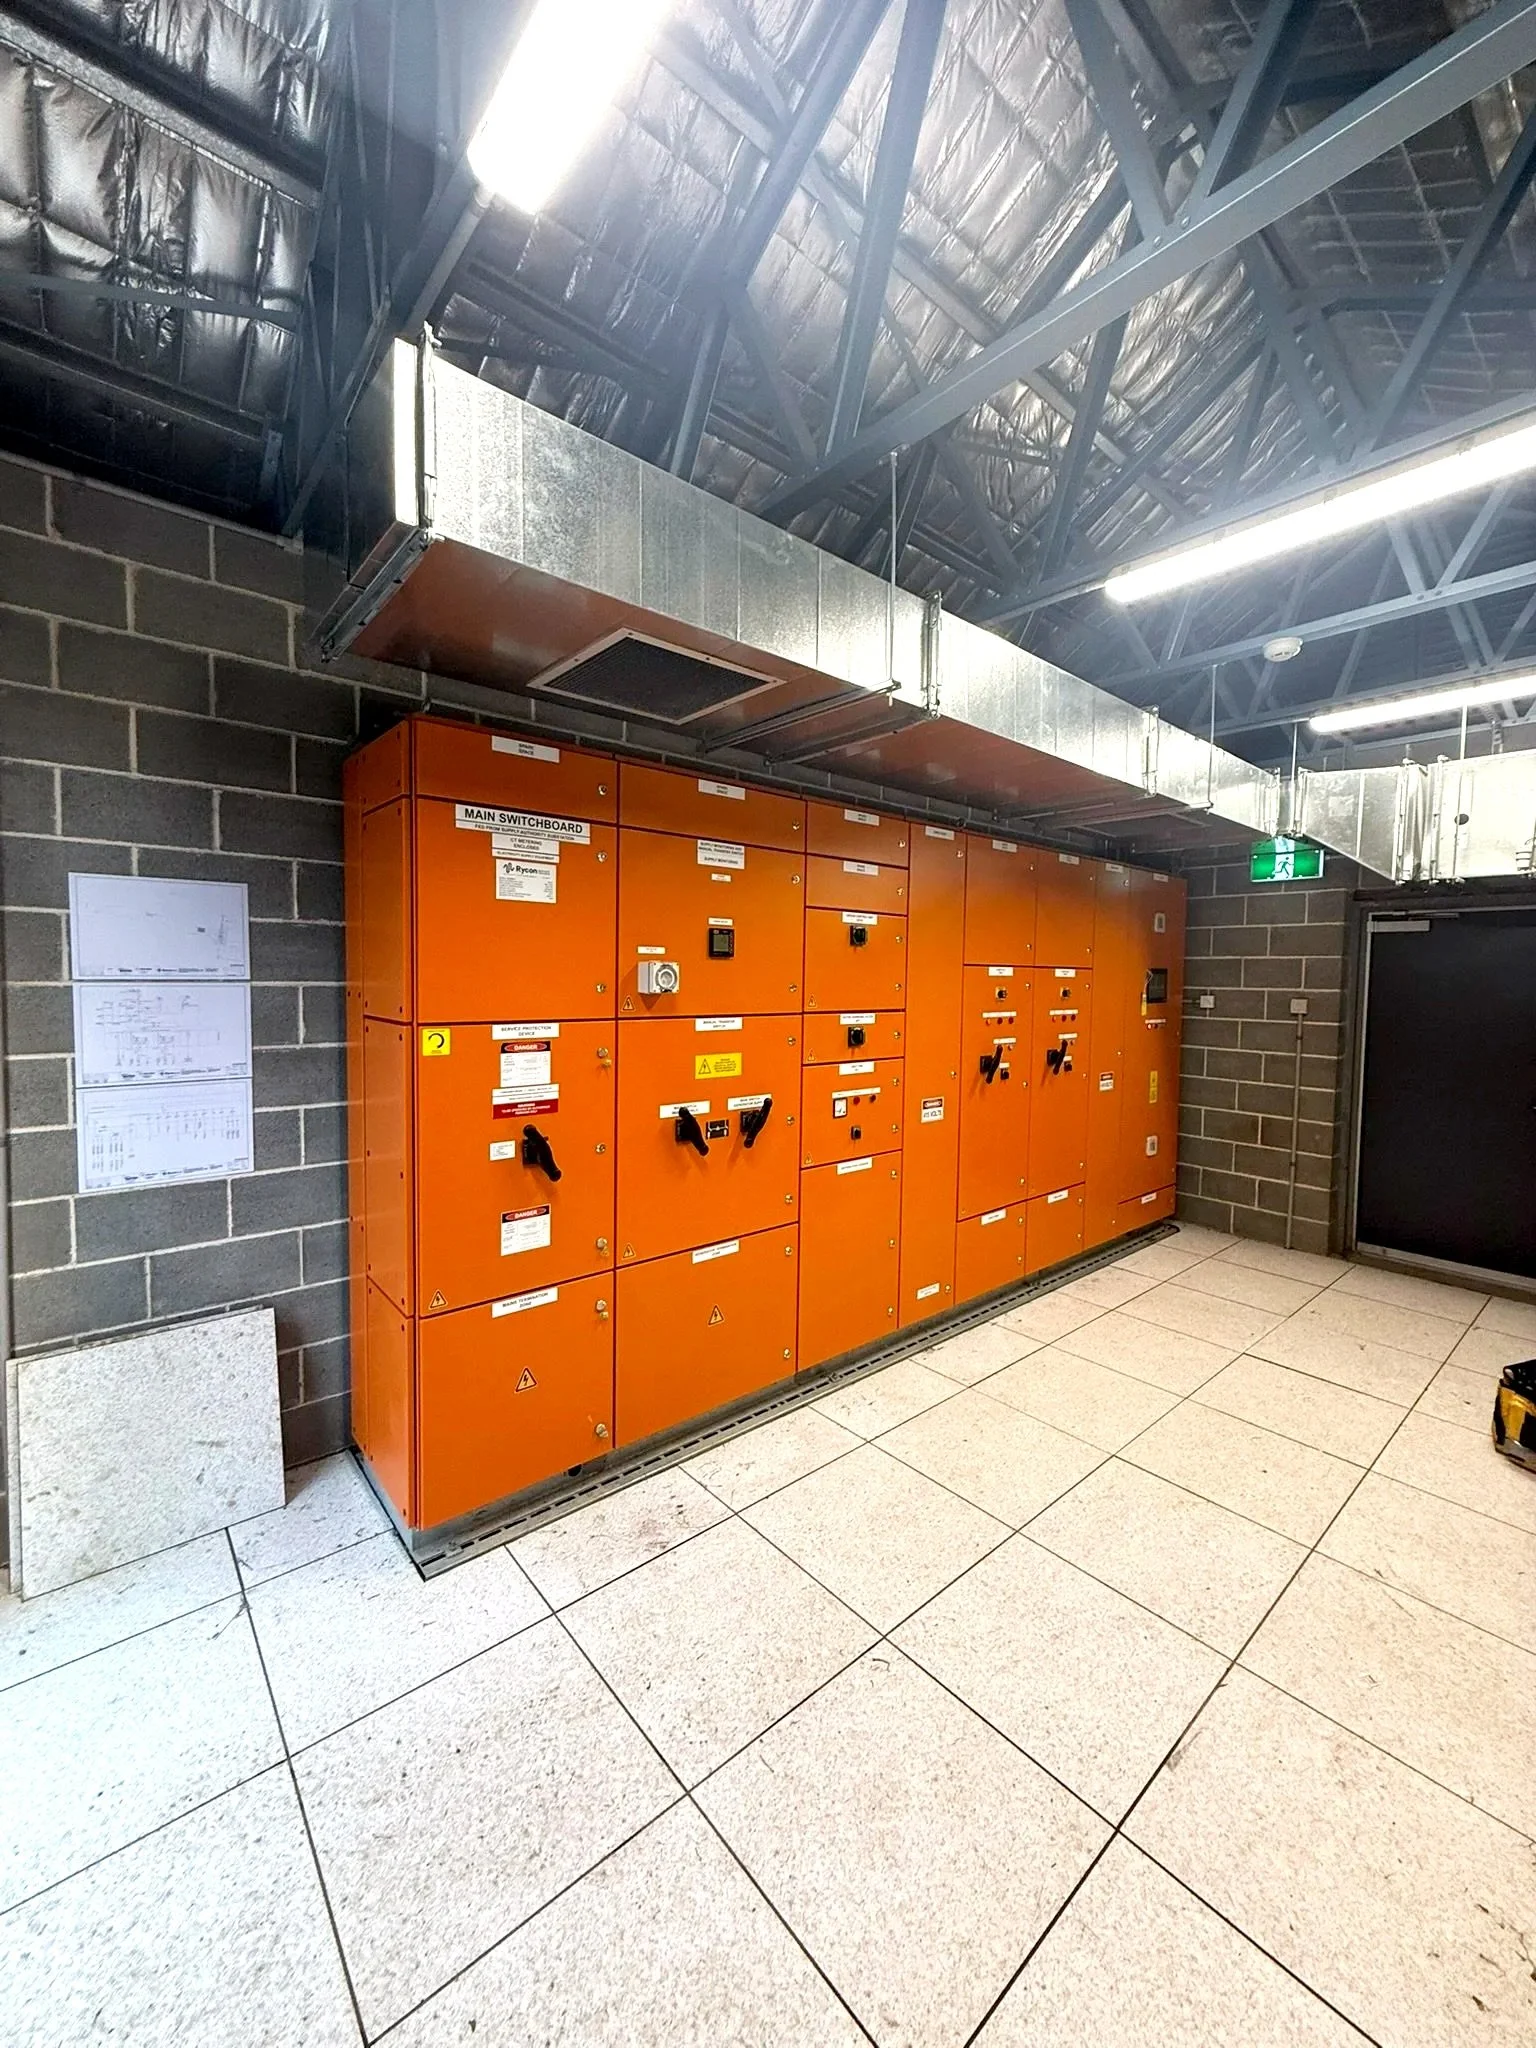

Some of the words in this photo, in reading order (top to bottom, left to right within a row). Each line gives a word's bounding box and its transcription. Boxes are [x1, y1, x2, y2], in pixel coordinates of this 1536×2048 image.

[464, 808, 496, 822] MAIN
[499, 813, 583, 834] SWITCHBOARD
[520, 829, 547, 838] AUTHORITY
[547, 833, 575, 841] SUBSTATION
[516, 865, 538, 874] Rycon
[514, 1210, 538, 1219] DANGER
